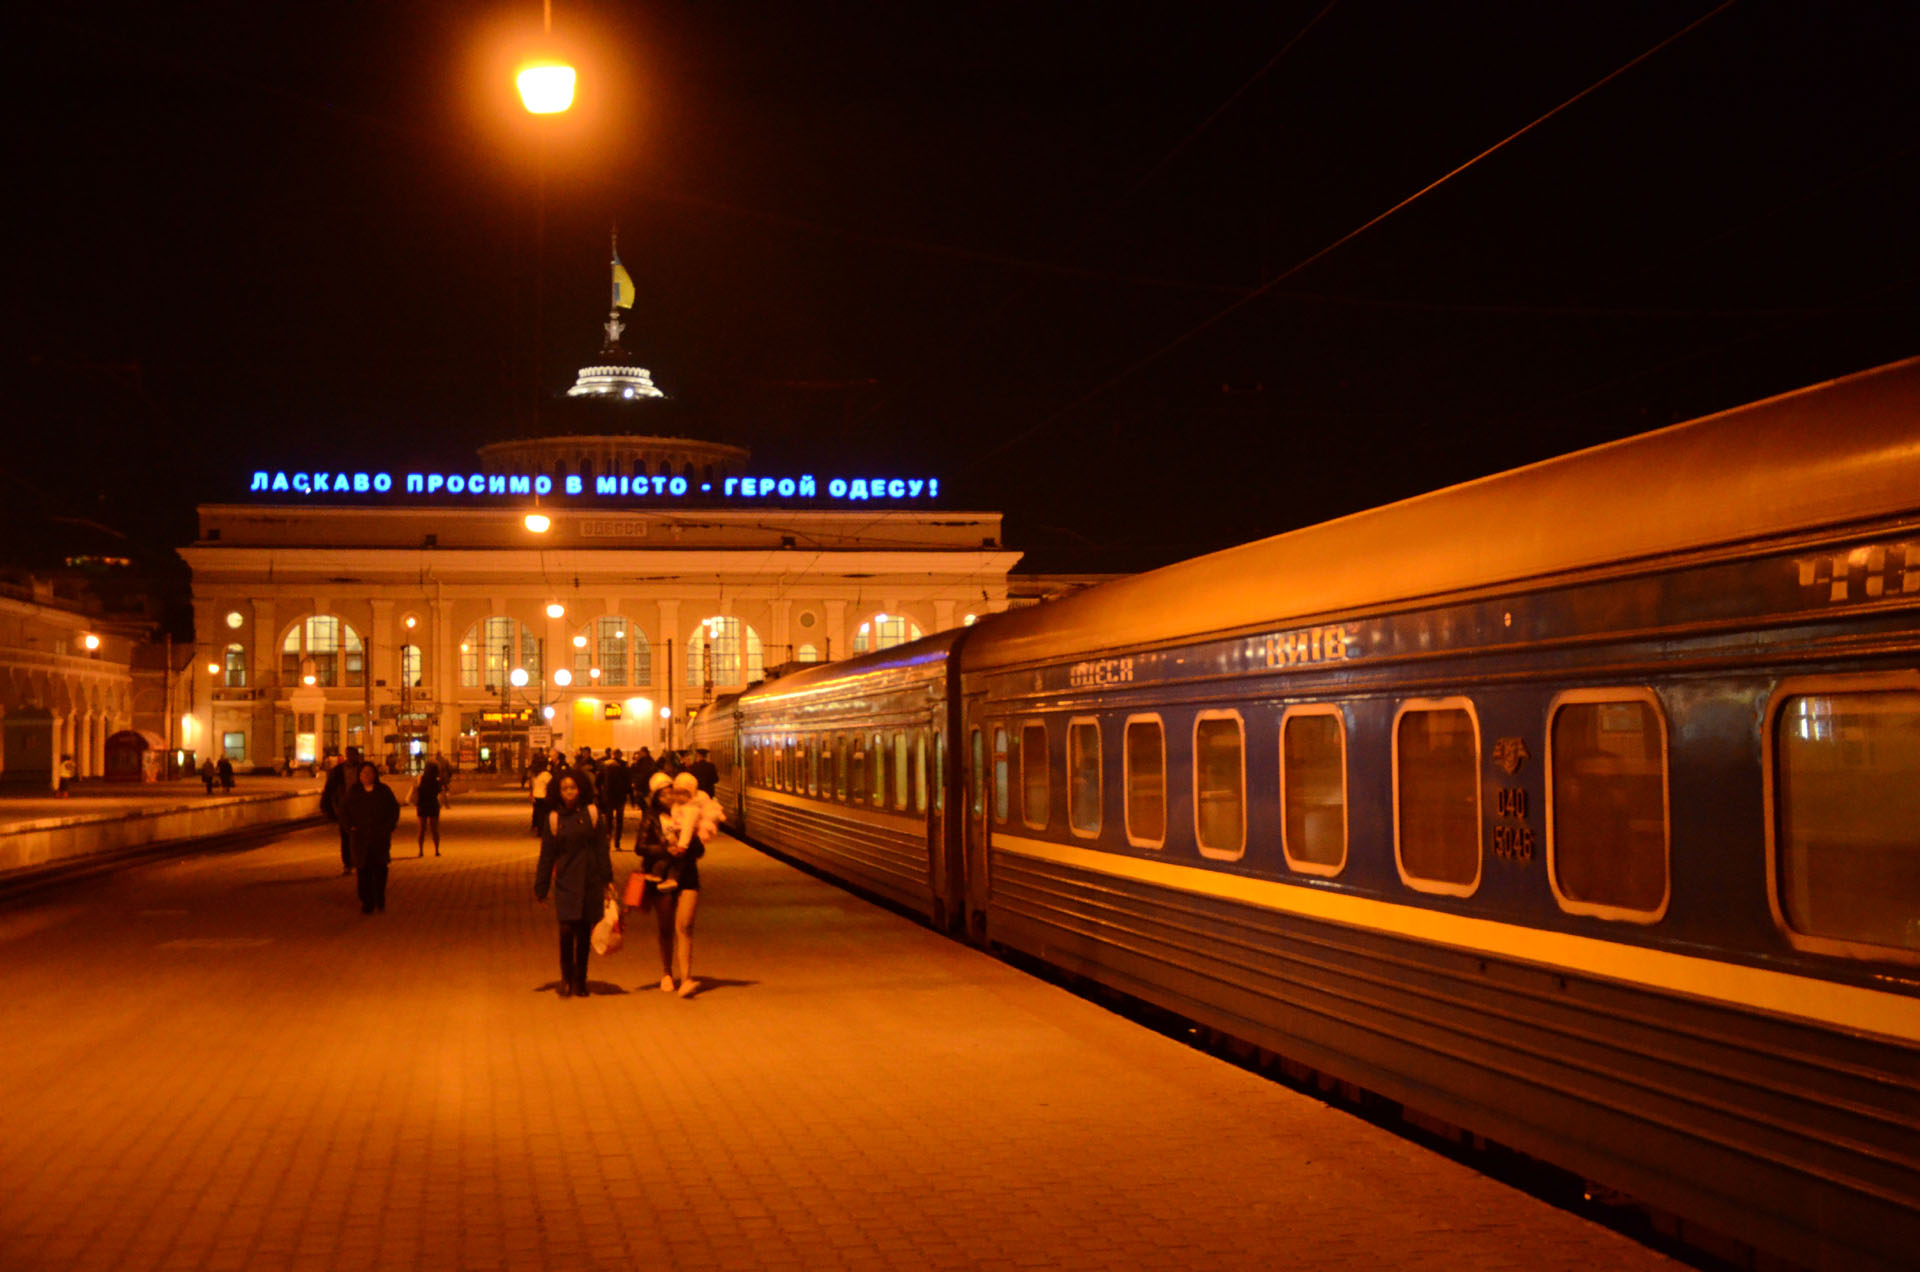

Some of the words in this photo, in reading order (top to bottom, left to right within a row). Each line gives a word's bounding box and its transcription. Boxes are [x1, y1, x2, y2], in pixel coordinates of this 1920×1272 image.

[250, 471, 392, 494] ЛАСКАВО
[406, 473, 552, 495] ПРОСИМО
[565, 474, 583, 495] В
[596, 475, 688, 496] МІСТО
[724, 474, 816, 497] ГЕРОЙ
[828, 478, 939, 501] ОДЕСУ!
